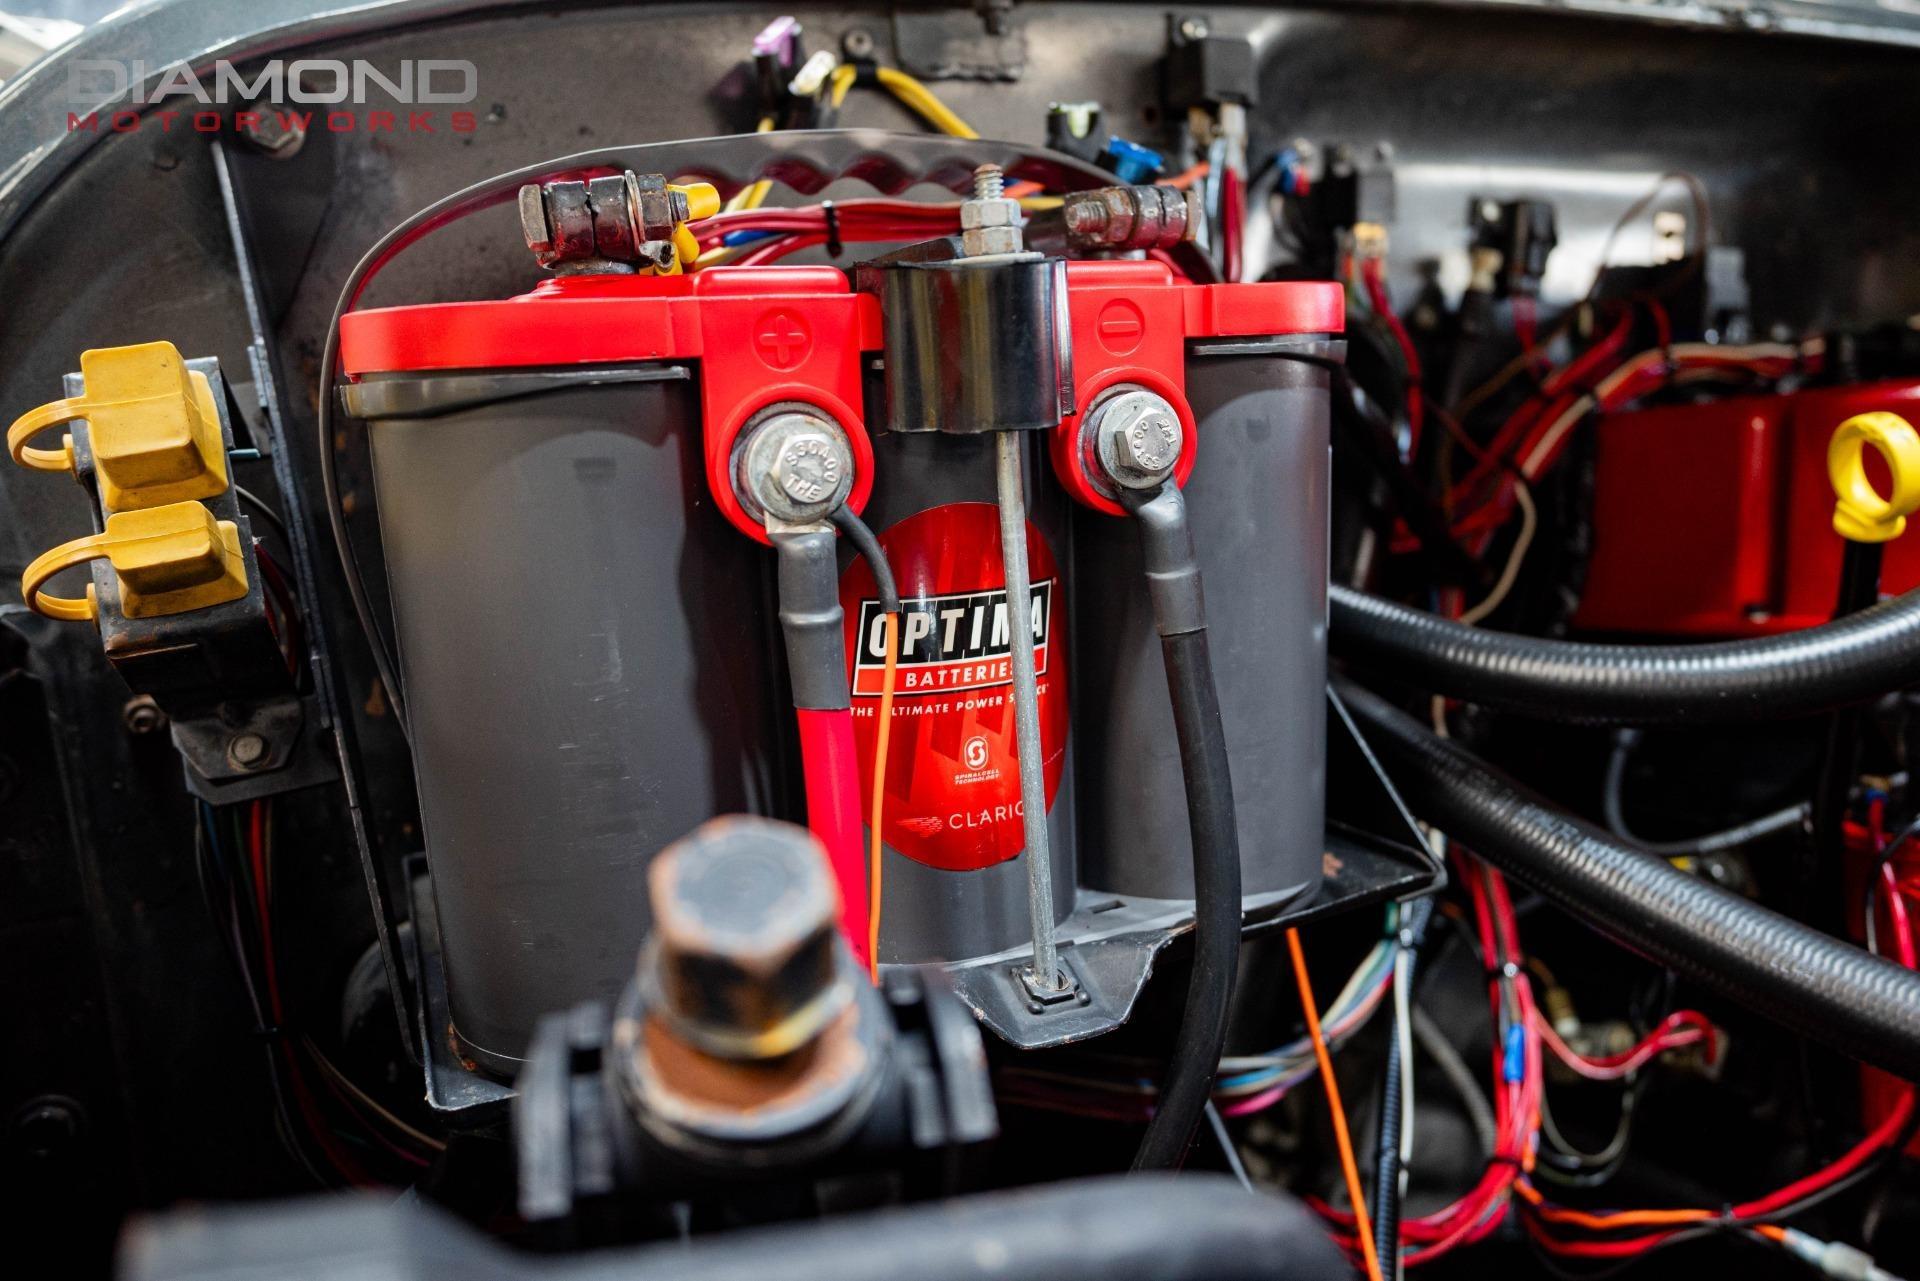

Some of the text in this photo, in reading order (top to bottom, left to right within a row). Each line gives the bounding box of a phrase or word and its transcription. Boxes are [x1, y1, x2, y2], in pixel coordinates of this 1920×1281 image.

[905, 660, 1014, 688] BATTERIE
[850, 706, 874, 717] THE
[891, 703, 949, 717] LTIMATE
[956, 695, 1003, 712] POWER
[949, 800, 1025, 830] CLARIO
